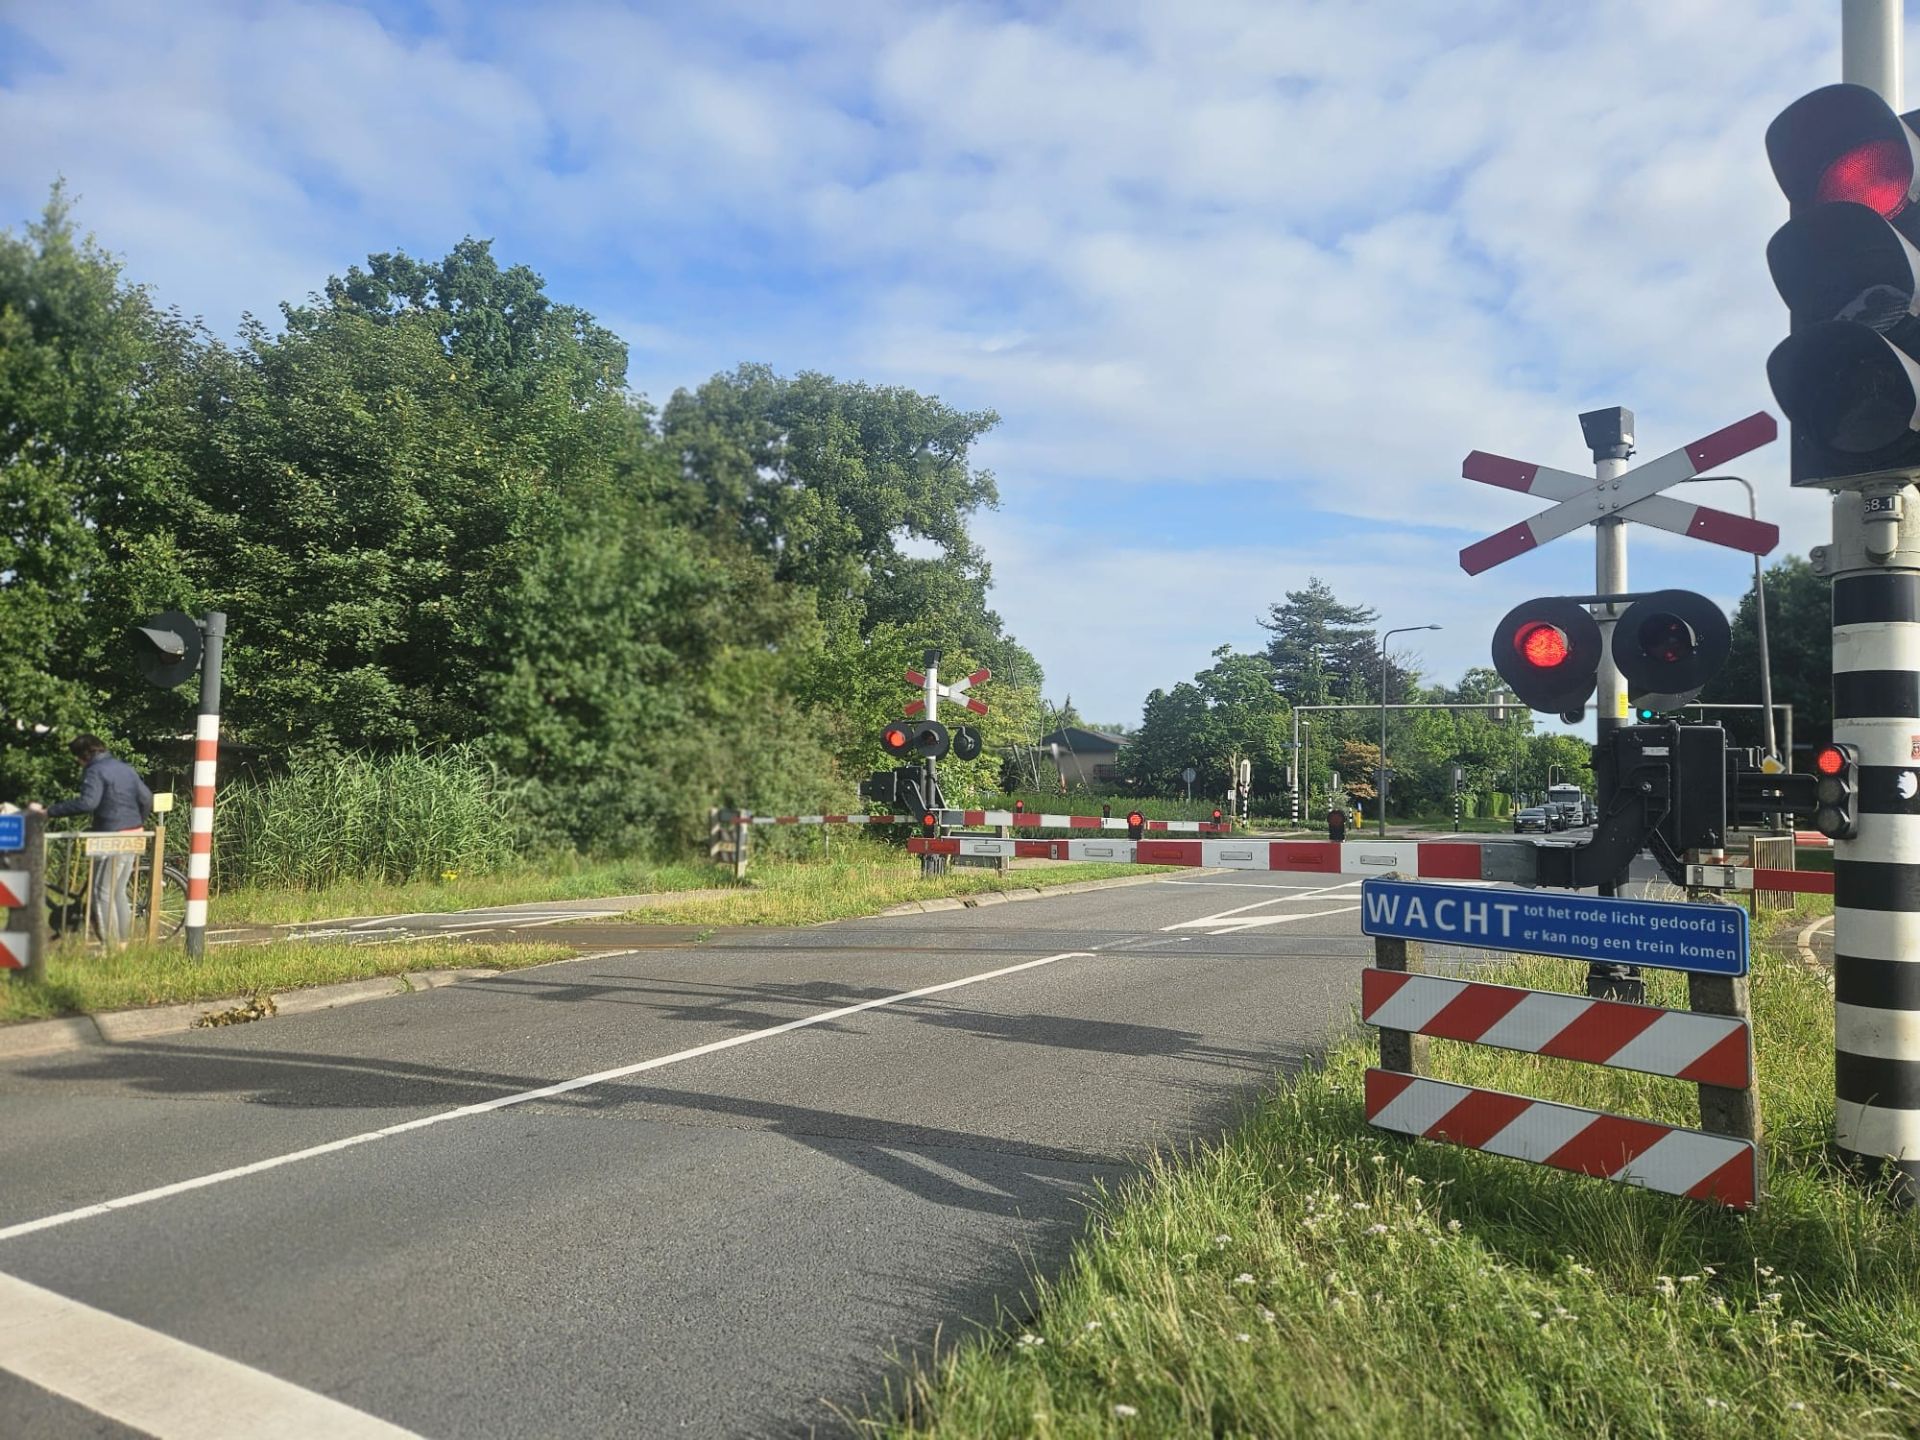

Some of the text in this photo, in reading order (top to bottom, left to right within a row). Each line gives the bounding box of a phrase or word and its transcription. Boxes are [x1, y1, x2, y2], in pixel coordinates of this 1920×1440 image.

[89, 837, 145, 851] HERAS
[1366, 892, 1519, 937] WACHT
[1524, 905, 1735, 934] tot het rode licht gedoofd is
[1523, 929, 1736, 961] er kan nog een trein komen
